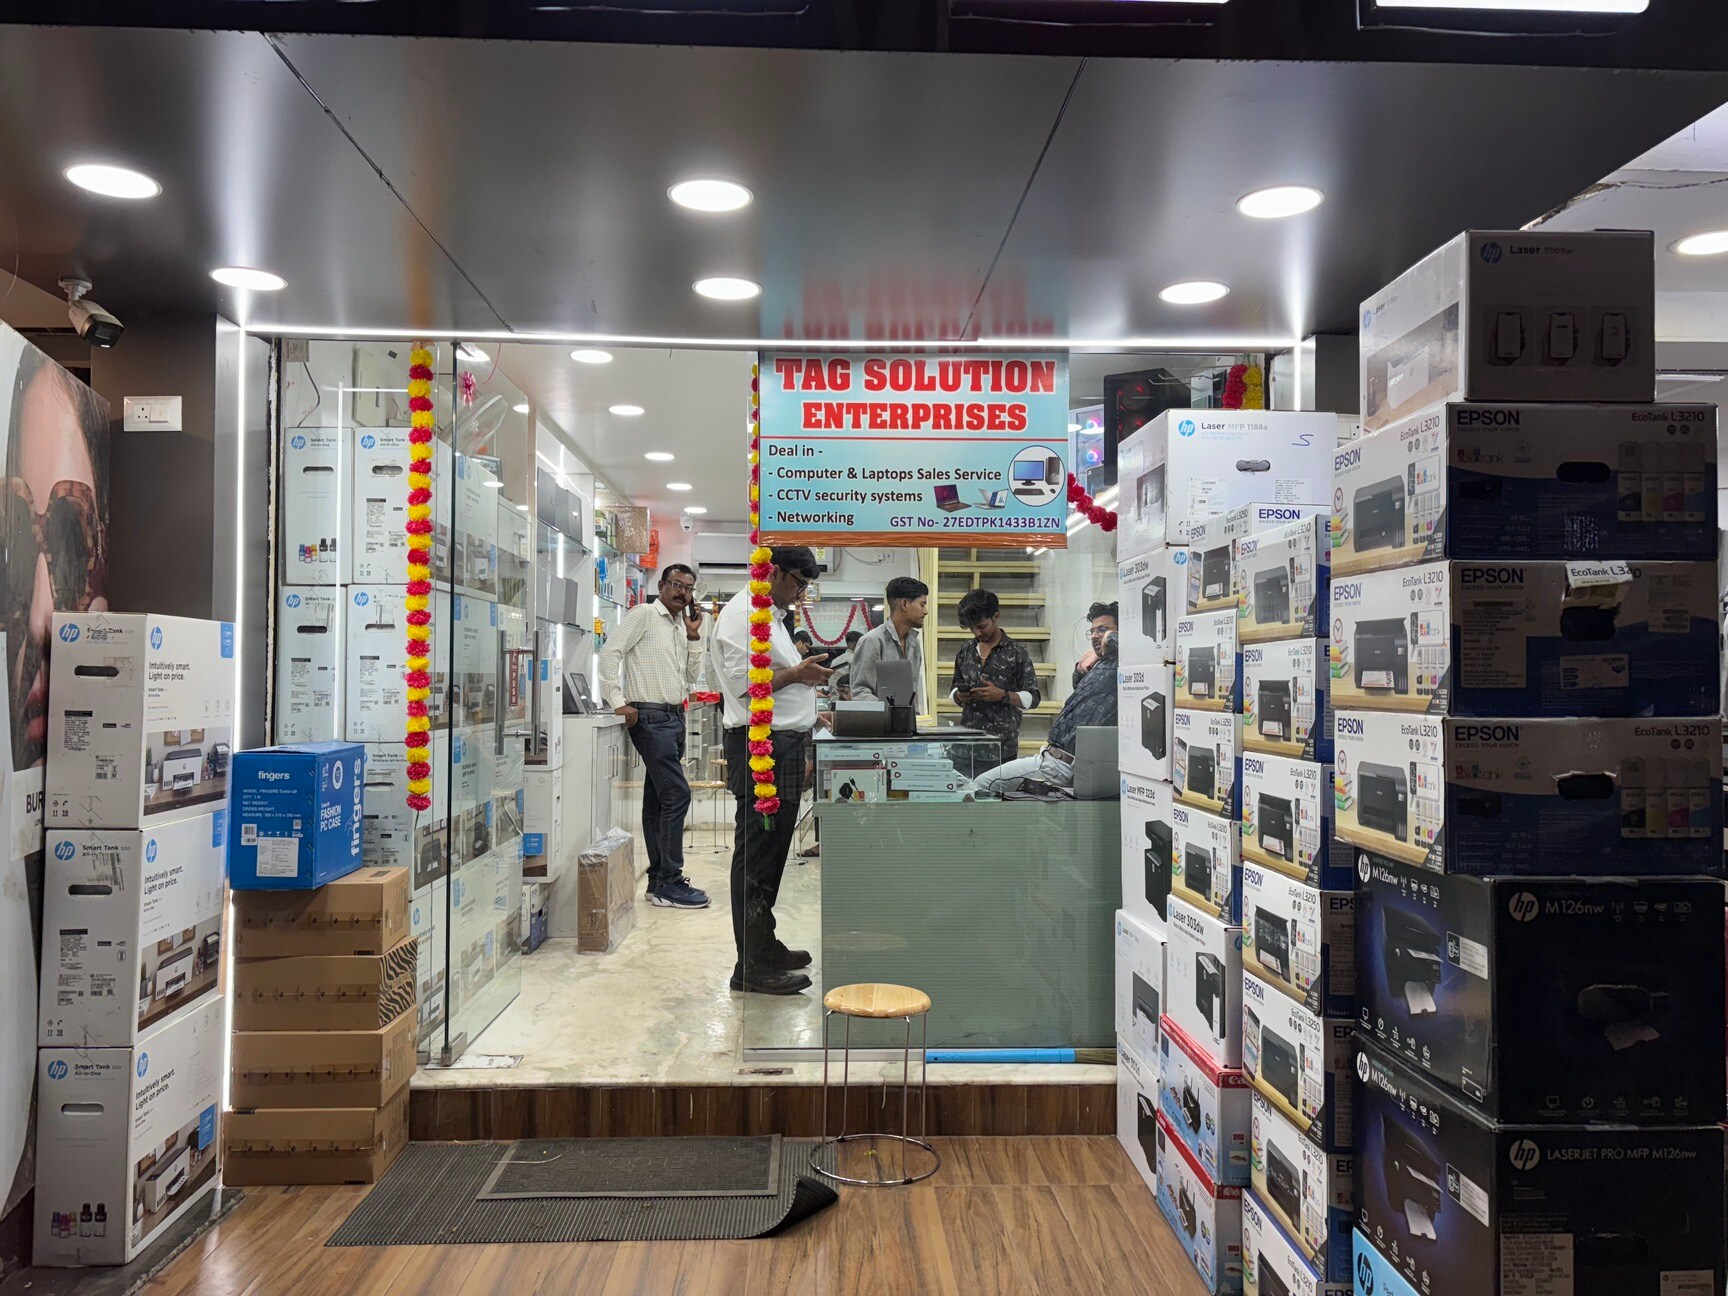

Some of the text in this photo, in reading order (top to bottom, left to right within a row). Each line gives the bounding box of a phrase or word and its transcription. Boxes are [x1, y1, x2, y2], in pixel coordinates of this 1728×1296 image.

[1480, 242, 1502, 264] hp
[1509, 246, 1540, 254] Laser
[775, 358, 1056, 393] TAG SOLUTION
[802, 402, 1027, 431] ENTERPRISES
[1457, 410, 1520, 425] EPSON
[1632, 411, 1704, 422] EcoTank L3210
[1178, 420, 1195, 437] hp
[1401, 415, 1440, 441] EcoTank L3210
[291, 435, 306, 449] hp
[361, 435, 375, 449] hp
[769, 445, 814, 456] Deal in
[1335, 448, 1360, 471] EPSON
[777, 467, 1002, 482] Computer & Laptops Sales Service
[777, 490, 922, 504] CCTV security systems
[777, 512, 854, 526] Networking
[1259, 509, 1300, 519] EPSON
[890, 517, 913, 527] GST
[943, 517, 1060, 528] 27EDTPK1433B1ZN
[1191, 525, 1206, 539] EPSON
[1241, 540, 1259, 556] EPSON
[1174, 552, 1187, 565] hp
[1123, 565, 1134, 578] Laser
[1403, 571, 1443, 587] EcoTank L3210
[1461, 568, 1524, 583] EPSON
[1571, 568, 1610, 577] EcoTank
[354, 592, 369, 606] hp
[1334, 583, 1361, 601] EPSON
[286, 594, 300, 608] hp
[59, 623, 80, 643] hp
[1179, 622, 1193, 633] EPSON
[151, 626, 162, 650] hp
[1245, 649, 1263, 662] EPSON
[1300, 645, 1312, 655] L3210
[149, 662, 174, 671] Intuitively
[149, 672, 161, 681] Light
[171, 672, 185, 681] price.
[1176, 714, 1190, 726] EPSON
[1338, 718, 1363, 735] EPSON
[1401, 725, 1437, 738] EcoTank L3210
[1455, 726, 1519, 741] EPSON
[1634, 726, 1710, 736] EcoTank L3210
[1245, 759, 1264, 773] EPSON
[258, 771, 290, 781] fingers
[1304, 769, 1316, 780] L3210
[1127, 784, 1136, 794] Laser
[321, 804, 341, 820] FASHION
[351, 758, 361, 857] fingers
[1174, 809, 1188, 823] EPSON
[320, 816, 341, 832] PC CASE
[55, 841, 75, 861] hp
[146, 839, 157, 863] hp
[1358, 854, 1370, 882] hp
[1373, 866, 1398, 885] M126nw
[144, 870, 168, 884] Intuitively
[1244, 868, 1263, 887] EPSON
[144, 884, 157, 895] Light
[165, 878, 178, 890] price.
[1302, 890, 1316, 904] L3210
[1509, 891, 1540, 923] hp
[1545, 902, 1604, 914] M126nw
[1173, 906, 1186, 923] Laser
[1187, 914, 1204, 935] 303dw
[1245, 978, 1264, 1001] EPSON
[1305, 1014, 1320, 1032] L3250
[48, 1060, 68, 1080] hp
[137, 1052, 148, 1078] hp
[1357, 1052, 1369, 1082] hp
[136, 1078, 160, 1100] Intuitively
[1372, 1068, 1397, 1096] M126nw
[135, 1083, 170, 1111] Light on price.
[1509, 1138, 1541, 1171] hp
[1547, 1149, 1697, 1160] LASERJET PRO MFP M126nw
[1244, 1199, 1263, 1232] EPSON
[1357, 1252, 1374, 1296] hp
